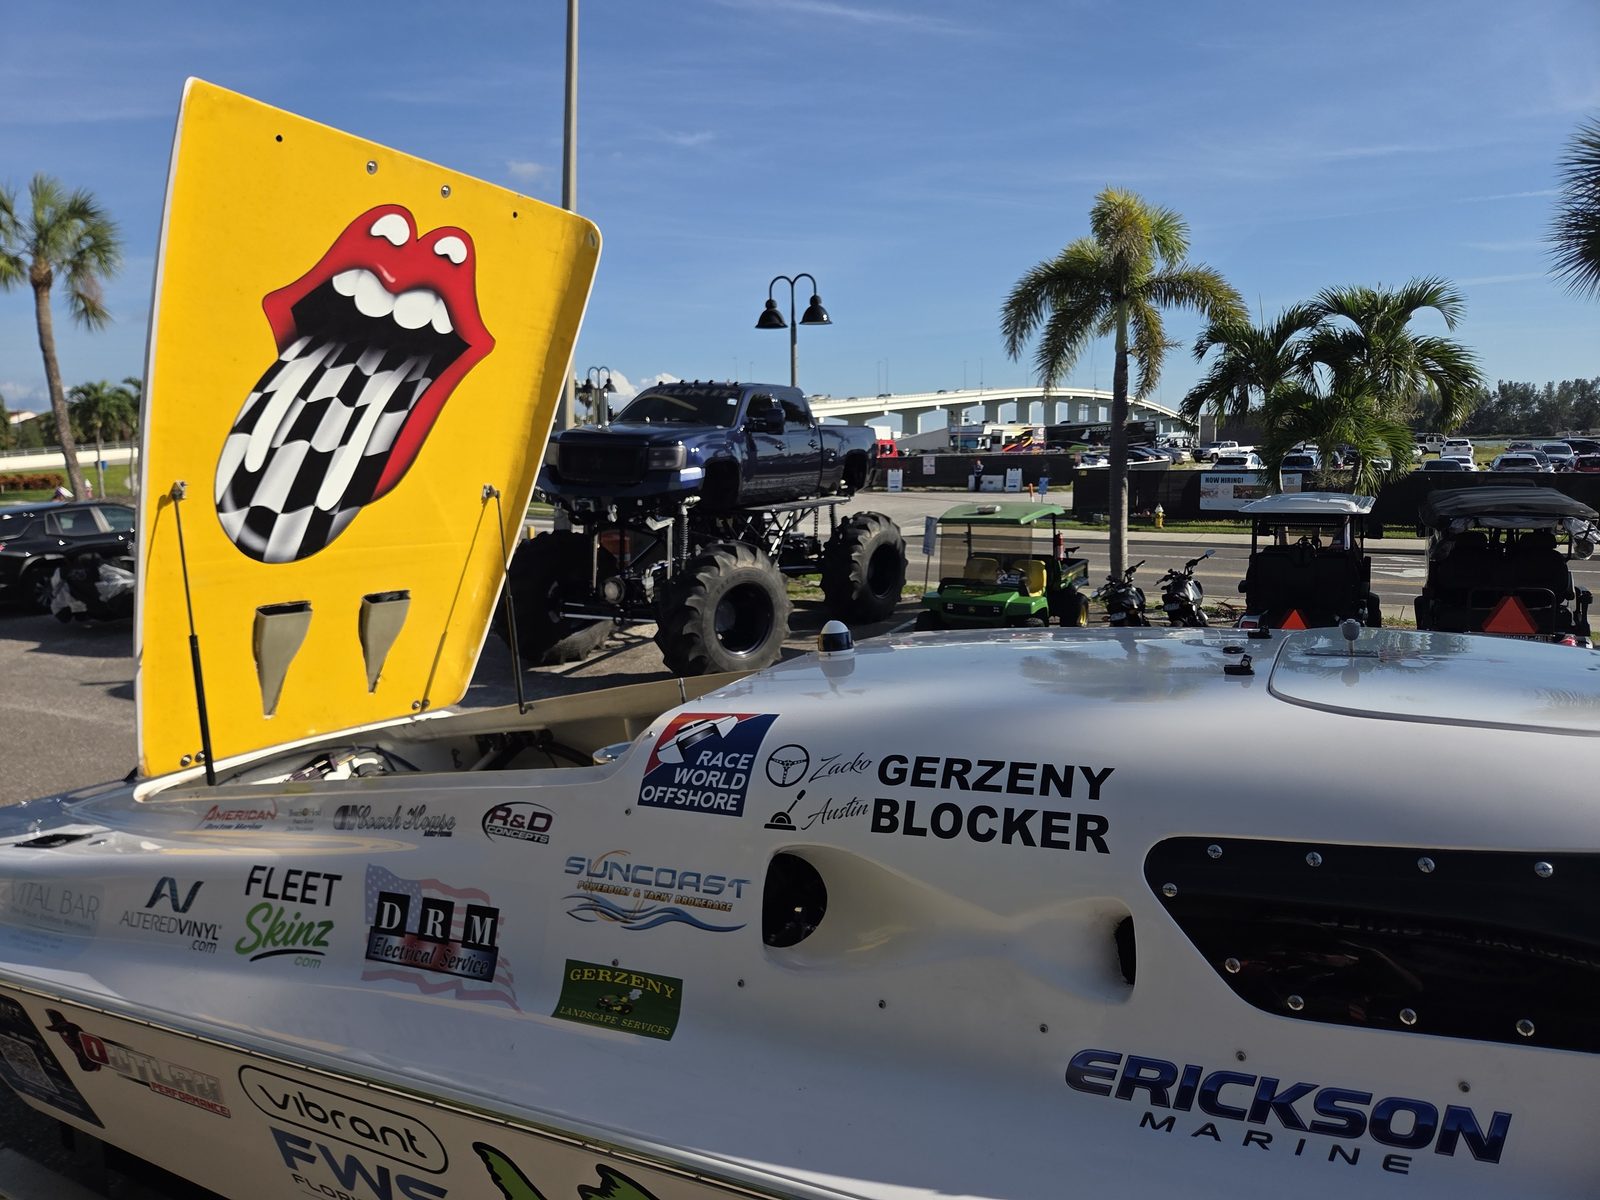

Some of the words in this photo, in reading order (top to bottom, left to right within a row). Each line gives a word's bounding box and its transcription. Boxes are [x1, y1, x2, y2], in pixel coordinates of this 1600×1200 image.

[1220, 477, 1244, 485] HIRING!
[696, 750, 754, 770] RACE
[673, 767, 747, 790] WORLD
[808, 752, 873, 784] Zacko
[877, 754, 1116, 801] GERZENY
[203, 805, 277, 821] AMERICAN
[641, 785, 742, 811] OFFSHORE
[487, 805, 554, 833] R&D
[801, 796, 870, 831] Austin
[870, 798, 1111, 855] BLOCKER
[487, 826, 549, 844] CONCEPTS
[244, 865, 343, 907] FLEET
[563, 855, 752, 899] SUNCOAST
[60, 889, 100, 920] BAR
[576, 880, 631, 897] POWERBOAT
[644, 890, 673, 905] YACHT
[674, 893, 734, 912] BROKERAGE
[235, 902, 335, 955] Skinz
[372, 936, 437, 965] Electrical
[439, 949, 489, 975] Service
[569, 968, 676, 999] GERZENY
[559, 1006, 619, 1026] LANDSCAPE
[620, 1018, 671, 1036] SERVICES
[257, 1084, 428, 1159] vibrant
[1065, 1048, 1513, 1165] ERICKSON
[1138, 1111, 1413, 1175] MARINE
